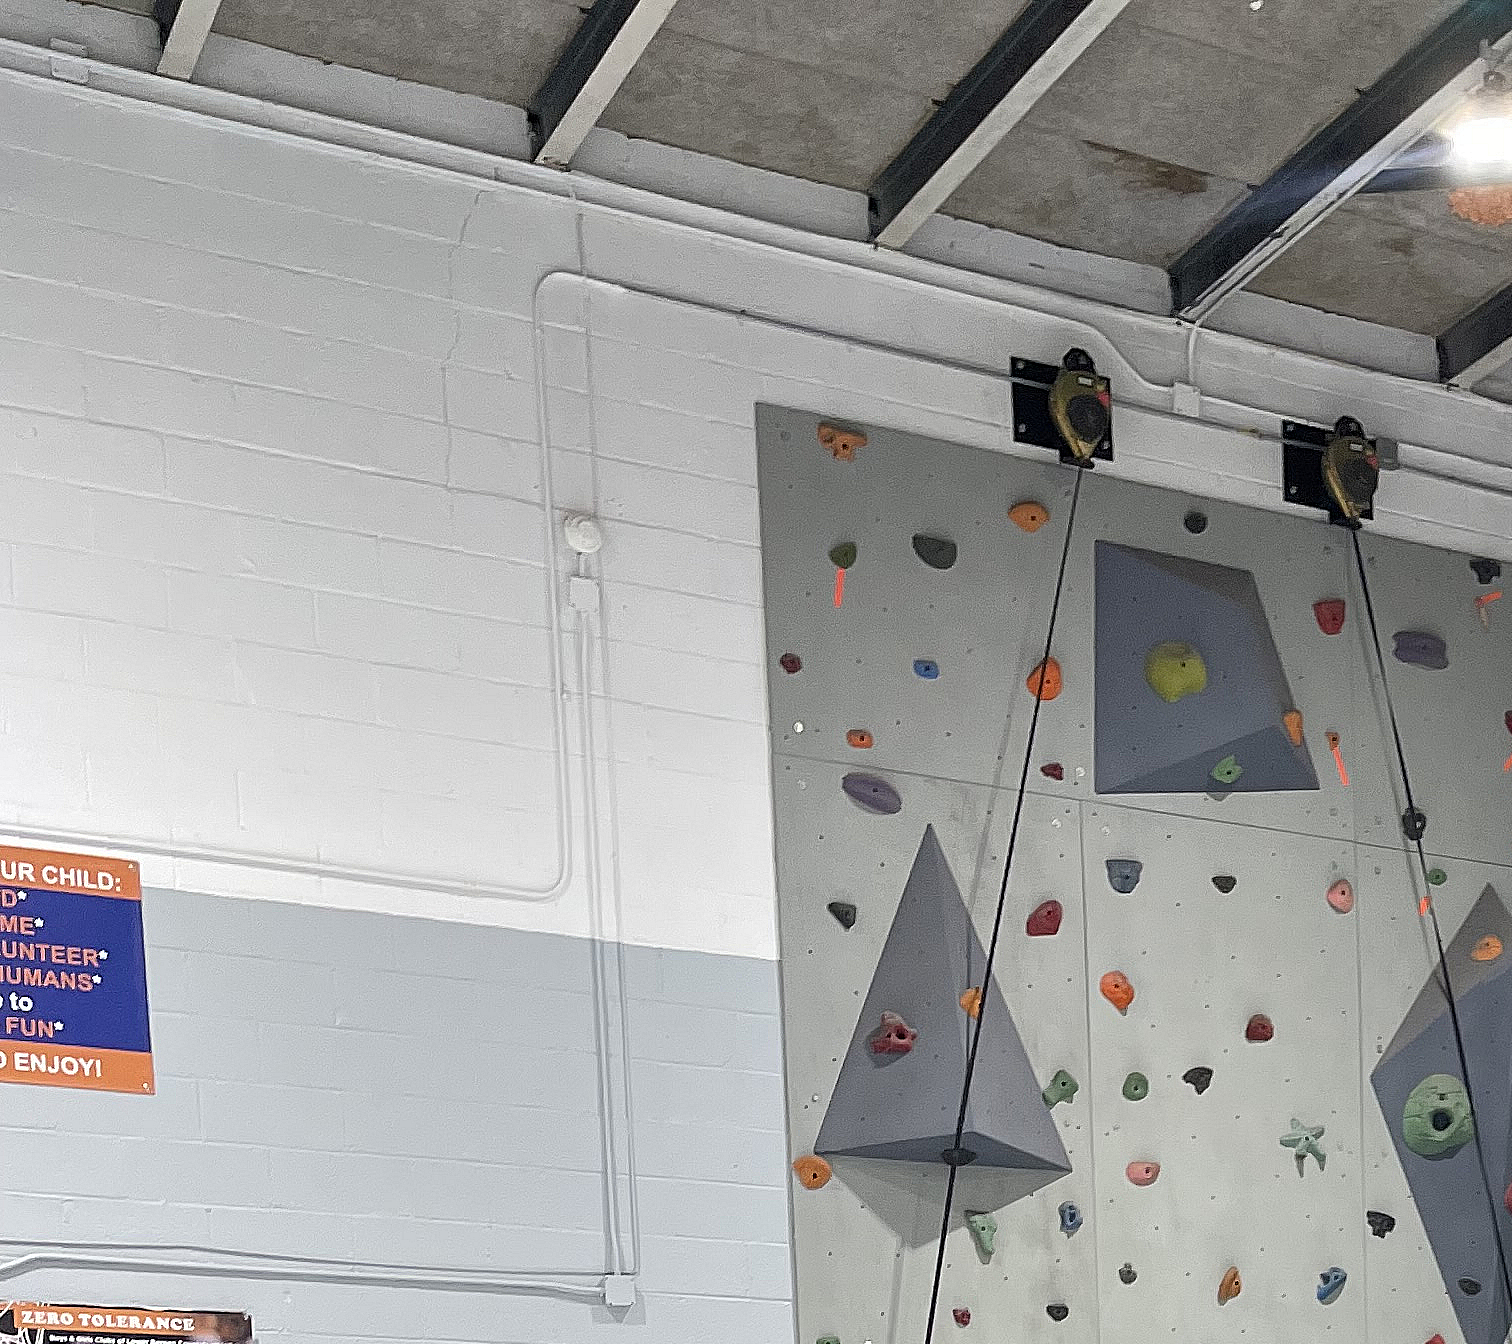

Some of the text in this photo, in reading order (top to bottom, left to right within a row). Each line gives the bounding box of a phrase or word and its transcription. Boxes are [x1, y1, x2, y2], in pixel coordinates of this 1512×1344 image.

[42, 865, 121, 892] CHILD:
[9, 992, 33, 1011] to
[21, 1310, 196, 1332] ZERO TOLERANCE
